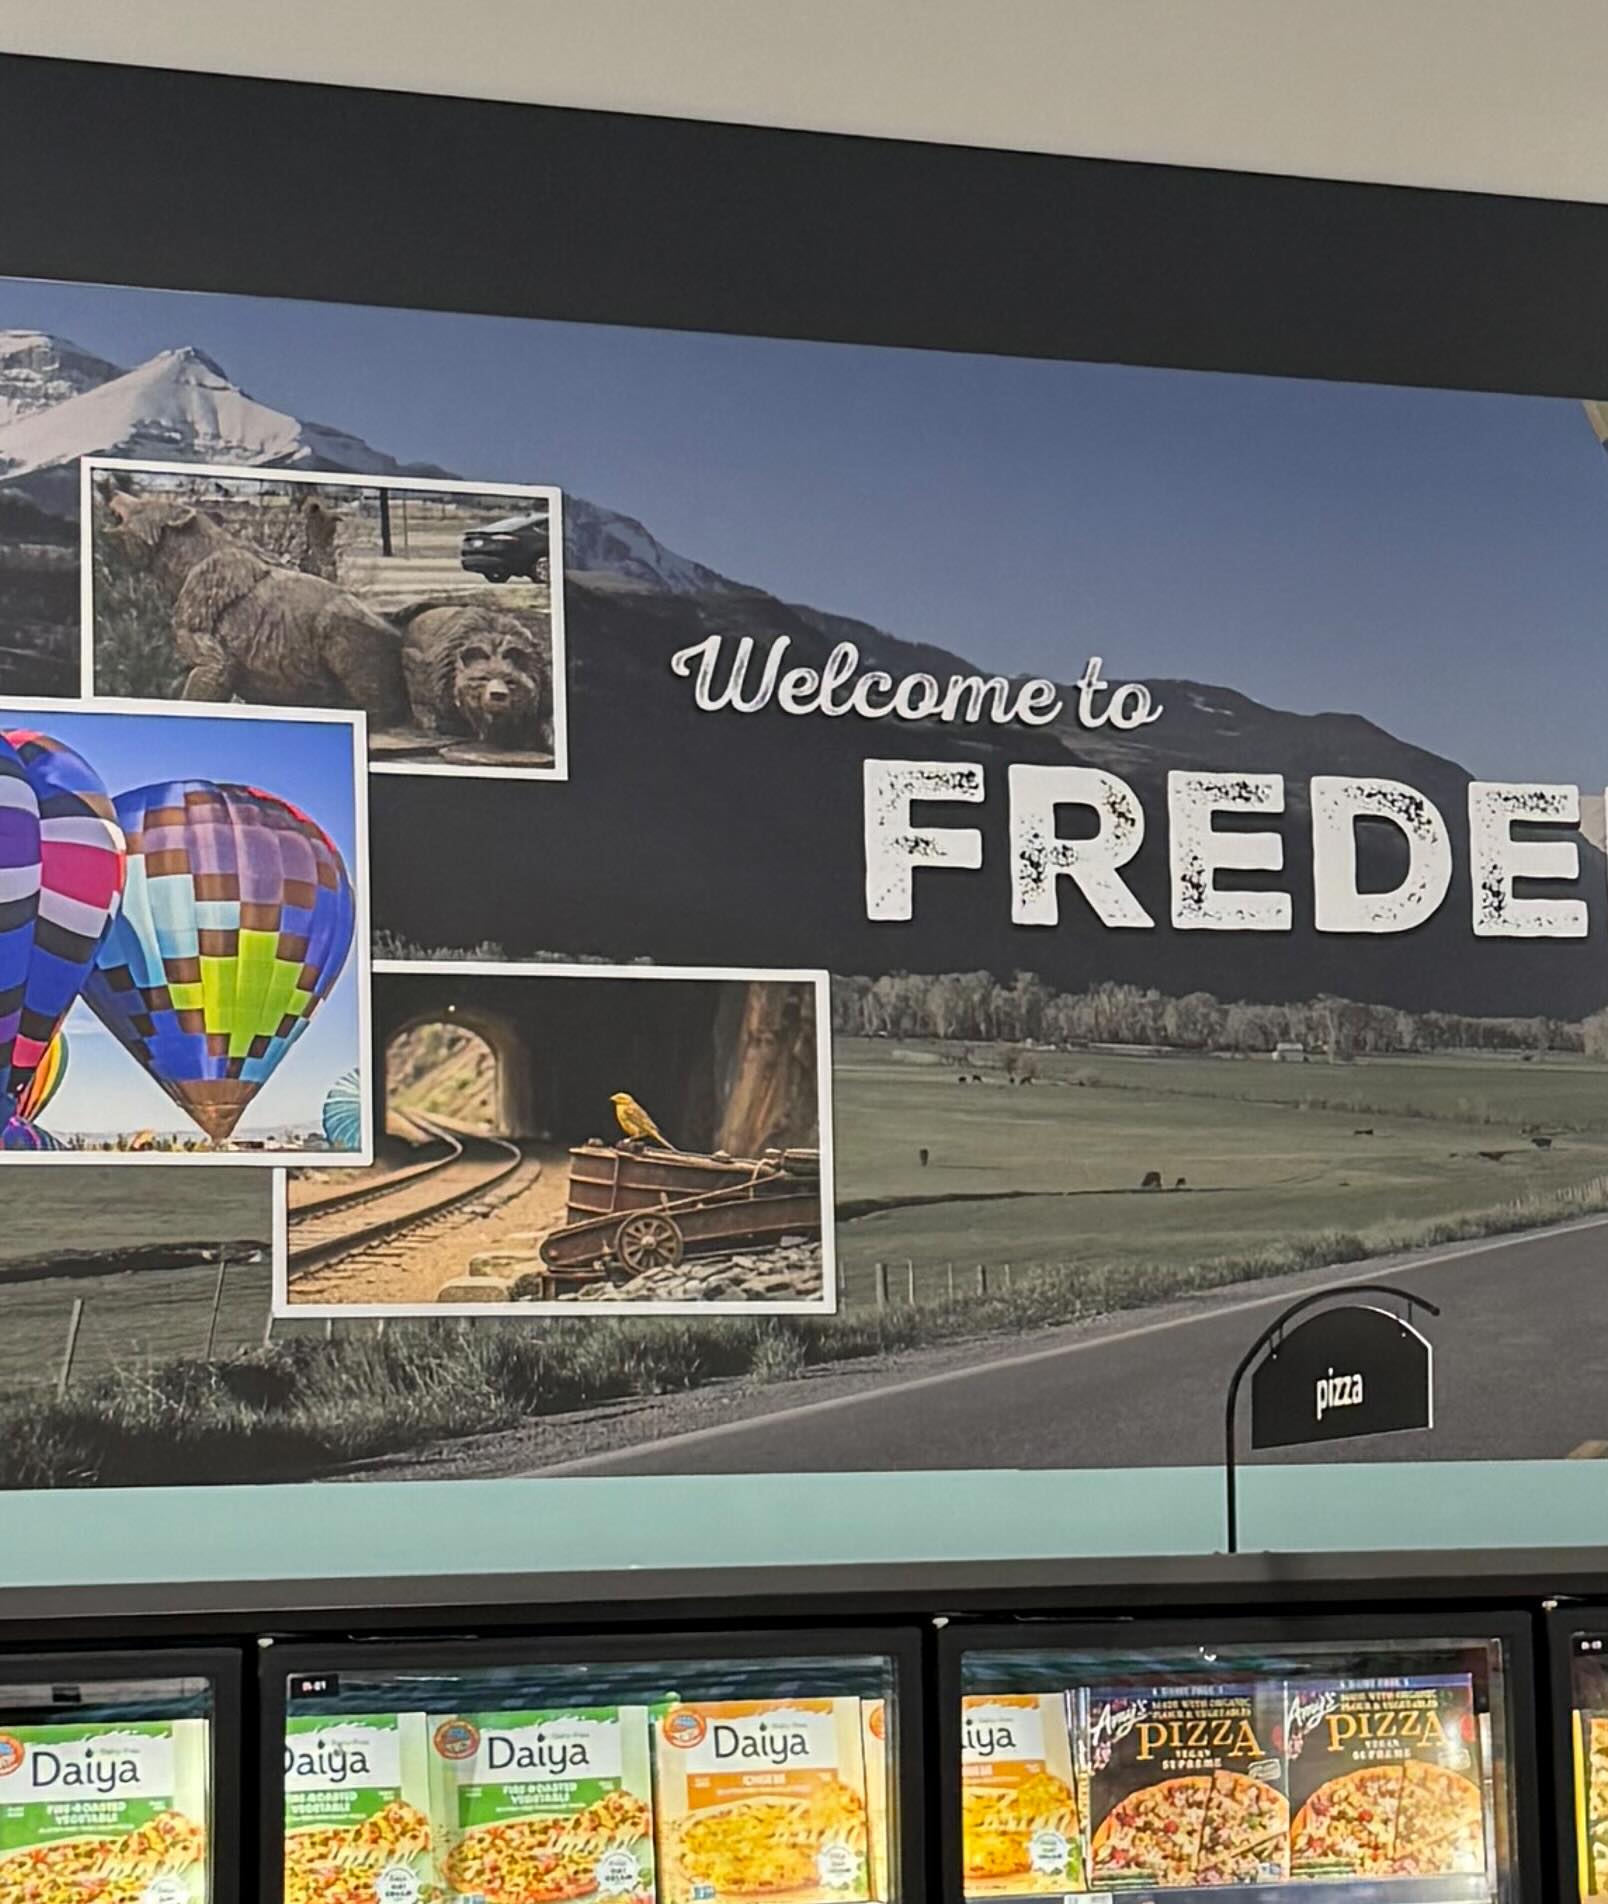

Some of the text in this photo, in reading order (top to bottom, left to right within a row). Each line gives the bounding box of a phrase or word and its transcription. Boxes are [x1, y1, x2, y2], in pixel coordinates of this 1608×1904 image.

[670, 634, 1162, 731] Welcome to
[1316, 1368, 1363, 1420] pizza
[1092, 1699, 1148, 1743] Amy's
[1287, 1692, 1340, 1735] Amy's
[1326, 1710, 1448, 1752] PIZZA
[488, 1733, 590, 1775] Daiya
[713, 1722, 810, 1764] Daiya
[1135, 1719, 1265, 1760] PIZZA
[32, 1749, 140, 1792] Daiya
